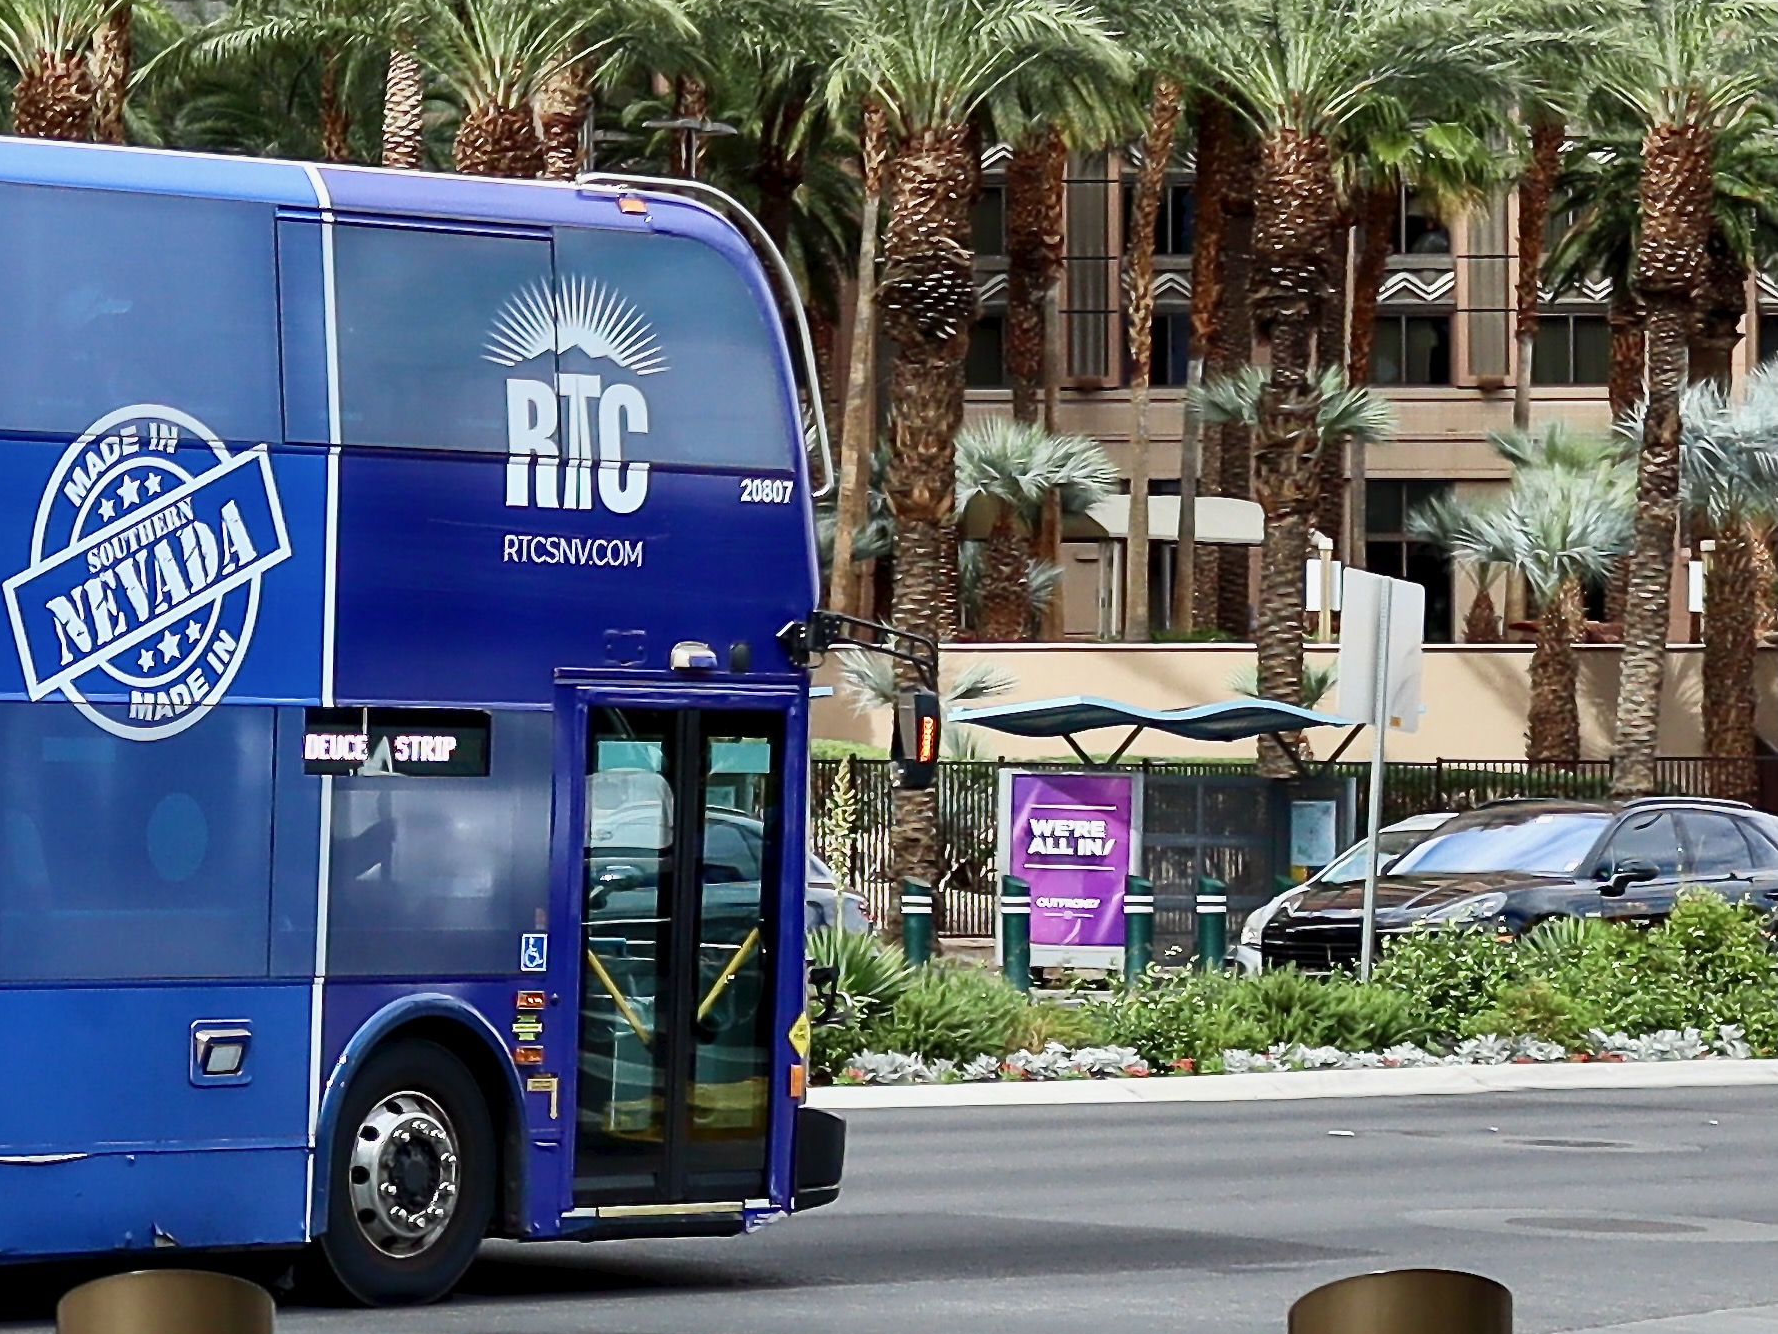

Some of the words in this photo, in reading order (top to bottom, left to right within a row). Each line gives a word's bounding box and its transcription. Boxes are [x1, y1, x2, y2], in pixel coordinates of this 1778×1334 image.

[63, 425, 139, 507] MADE
[149, 423, 178, 454] IN
[505, 373, 650, 513] RTC
[739, 479, 793, 503] 20807
[87, 497, 193, 573] SOUTHERN
[503, 535, 643, 568] RTCSNV.COM
[46, 499, 258, 665] NEVADA
[129, 668, 210, 721] MADE
[207, 630, 237, 671] IN
[304, 733, 369, 761] DEUCE
[395, 736, 457, 761] STRIP
[1027, 838, 1074, 856] ALL
[1028, 819, 1108, 839] WE'RE
